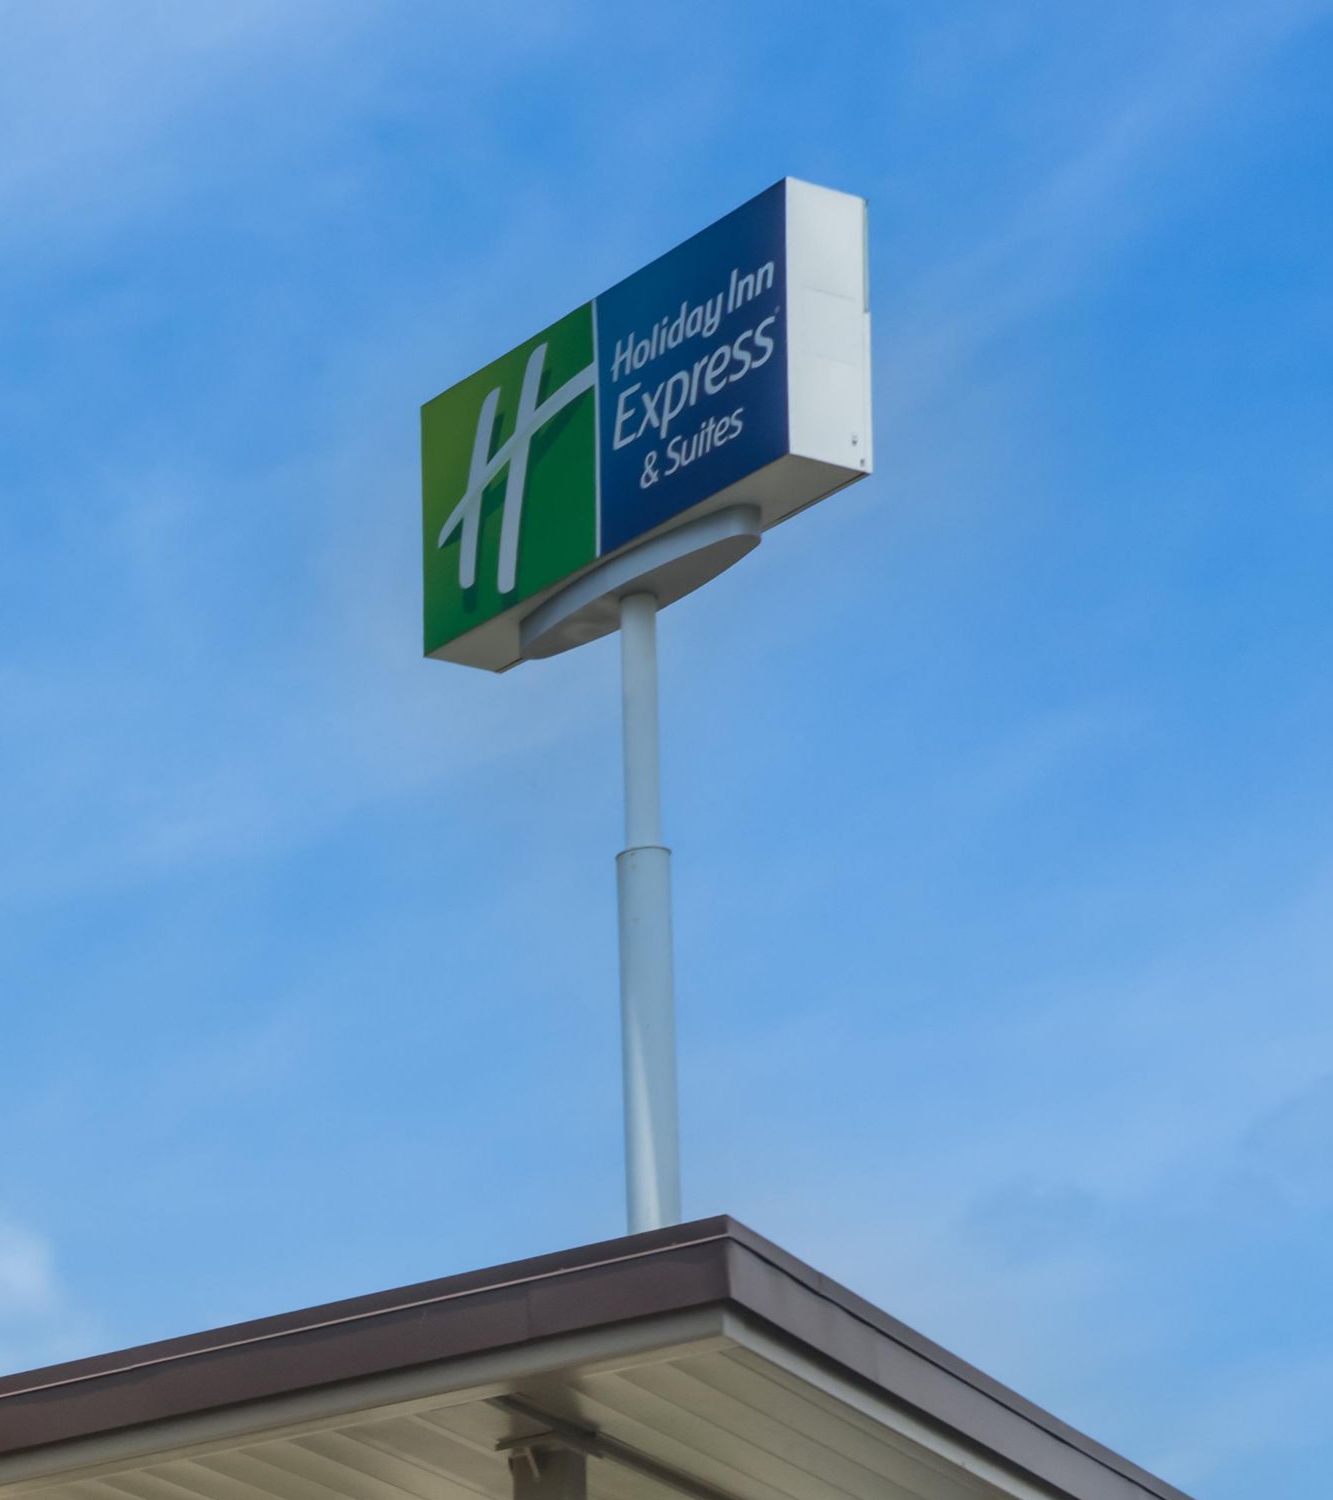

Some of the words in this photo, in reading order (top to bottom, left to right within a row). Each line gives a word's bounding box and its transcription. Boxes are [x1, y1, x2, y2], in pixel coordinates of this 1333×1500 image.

[610, 291, 725, 384] Holiday
[727, 259, 776, 315] Inn
[612, 314, 777, 451] Express
[639, 450, 660, 490] &
[663, 405, 745, 477] Suites
